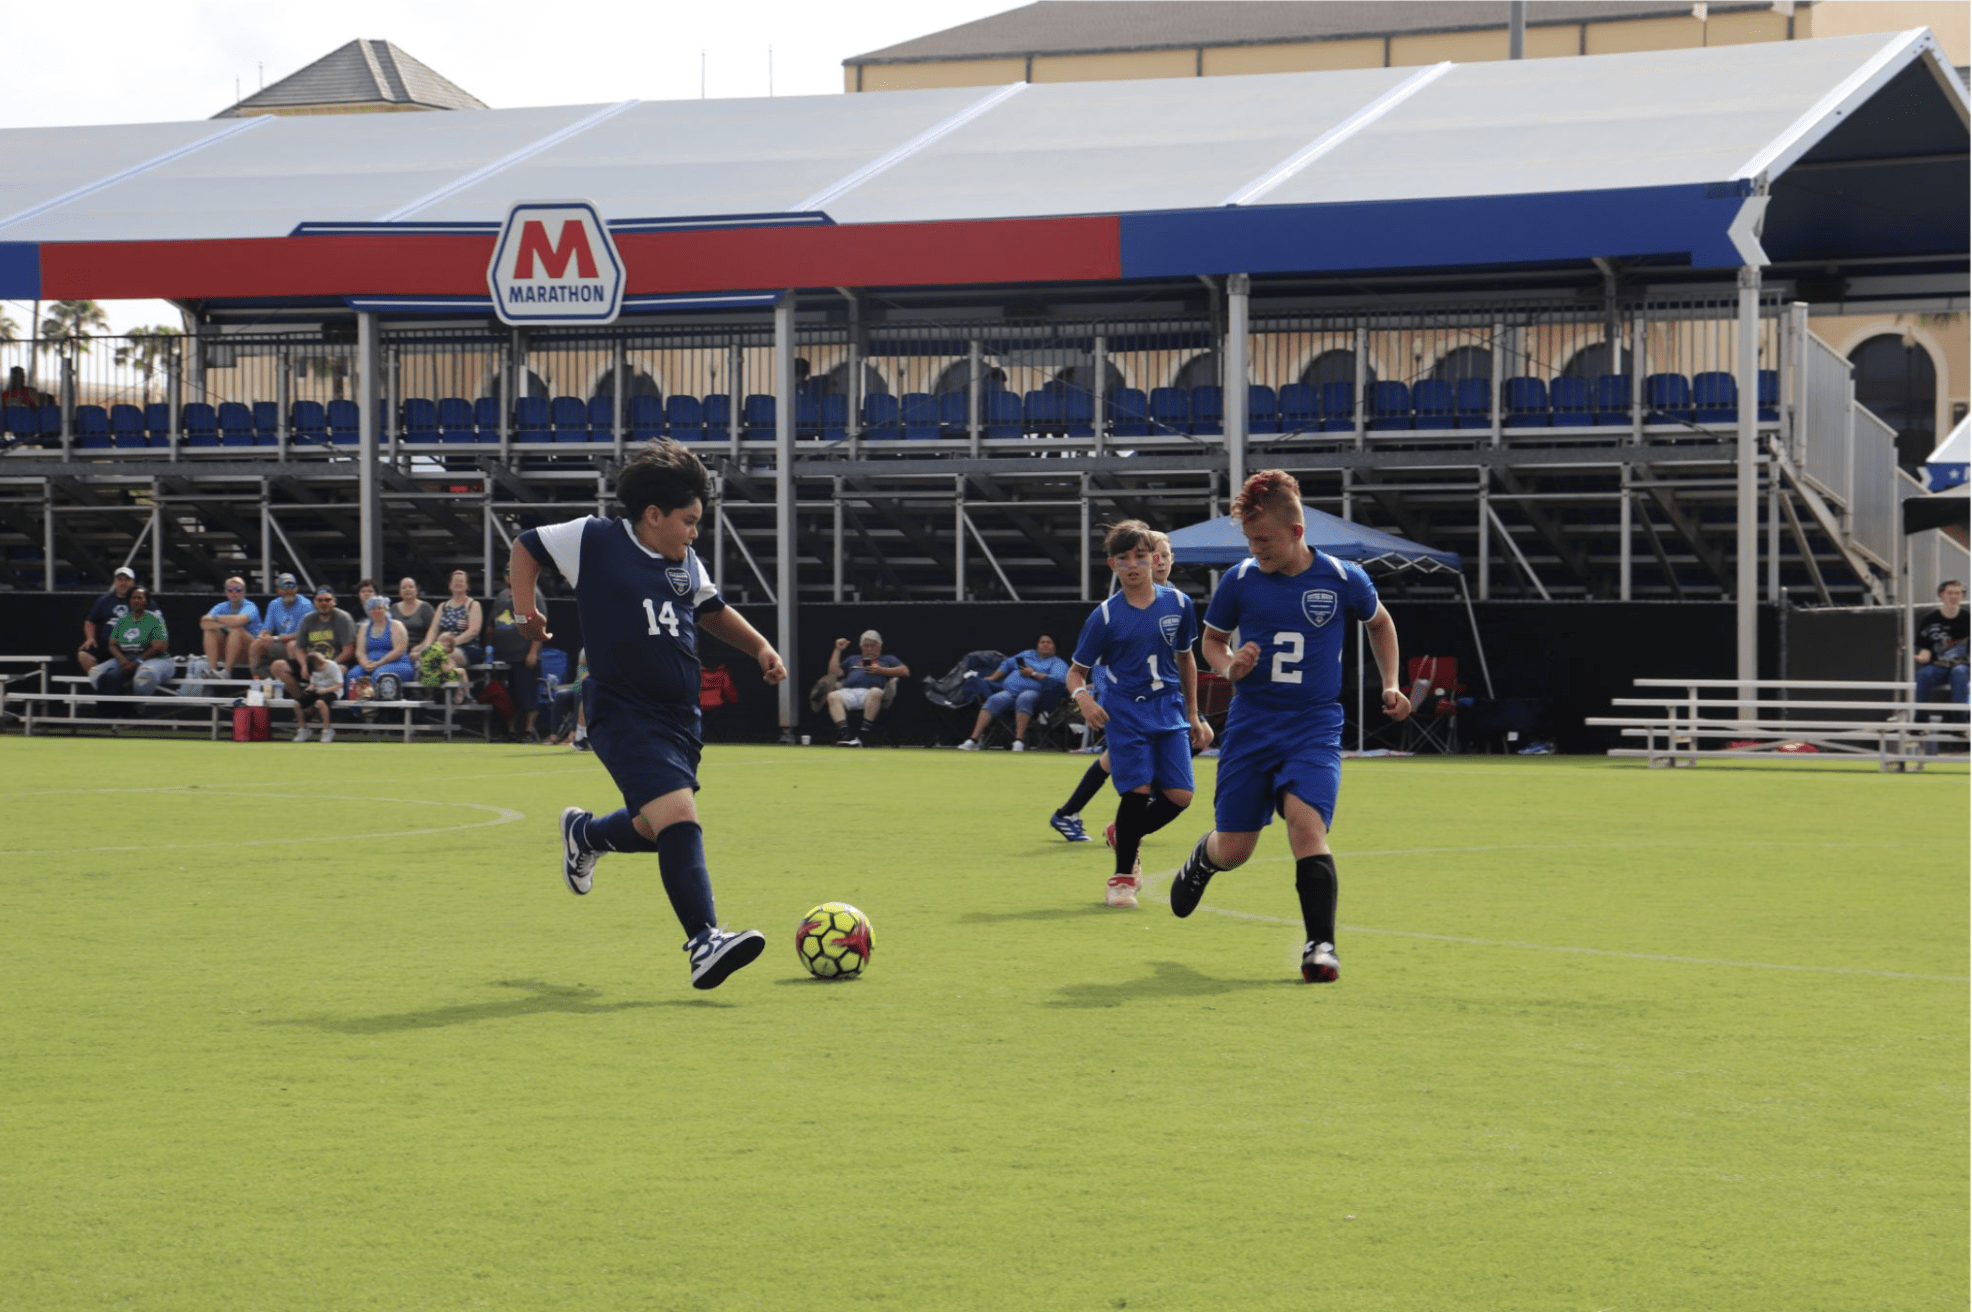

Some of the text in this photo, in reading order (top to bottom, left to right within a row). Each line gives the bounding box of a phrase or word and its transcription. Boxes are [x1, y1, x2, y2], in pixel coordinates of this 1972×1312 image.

[513, 220, 599, 279] M
[509, 284, 605, 303] MARATHON
[642, 598, 680, 637] 14
[1147, 654, 1165, 691] 1
[1271, 631, 1305, 684] 2
